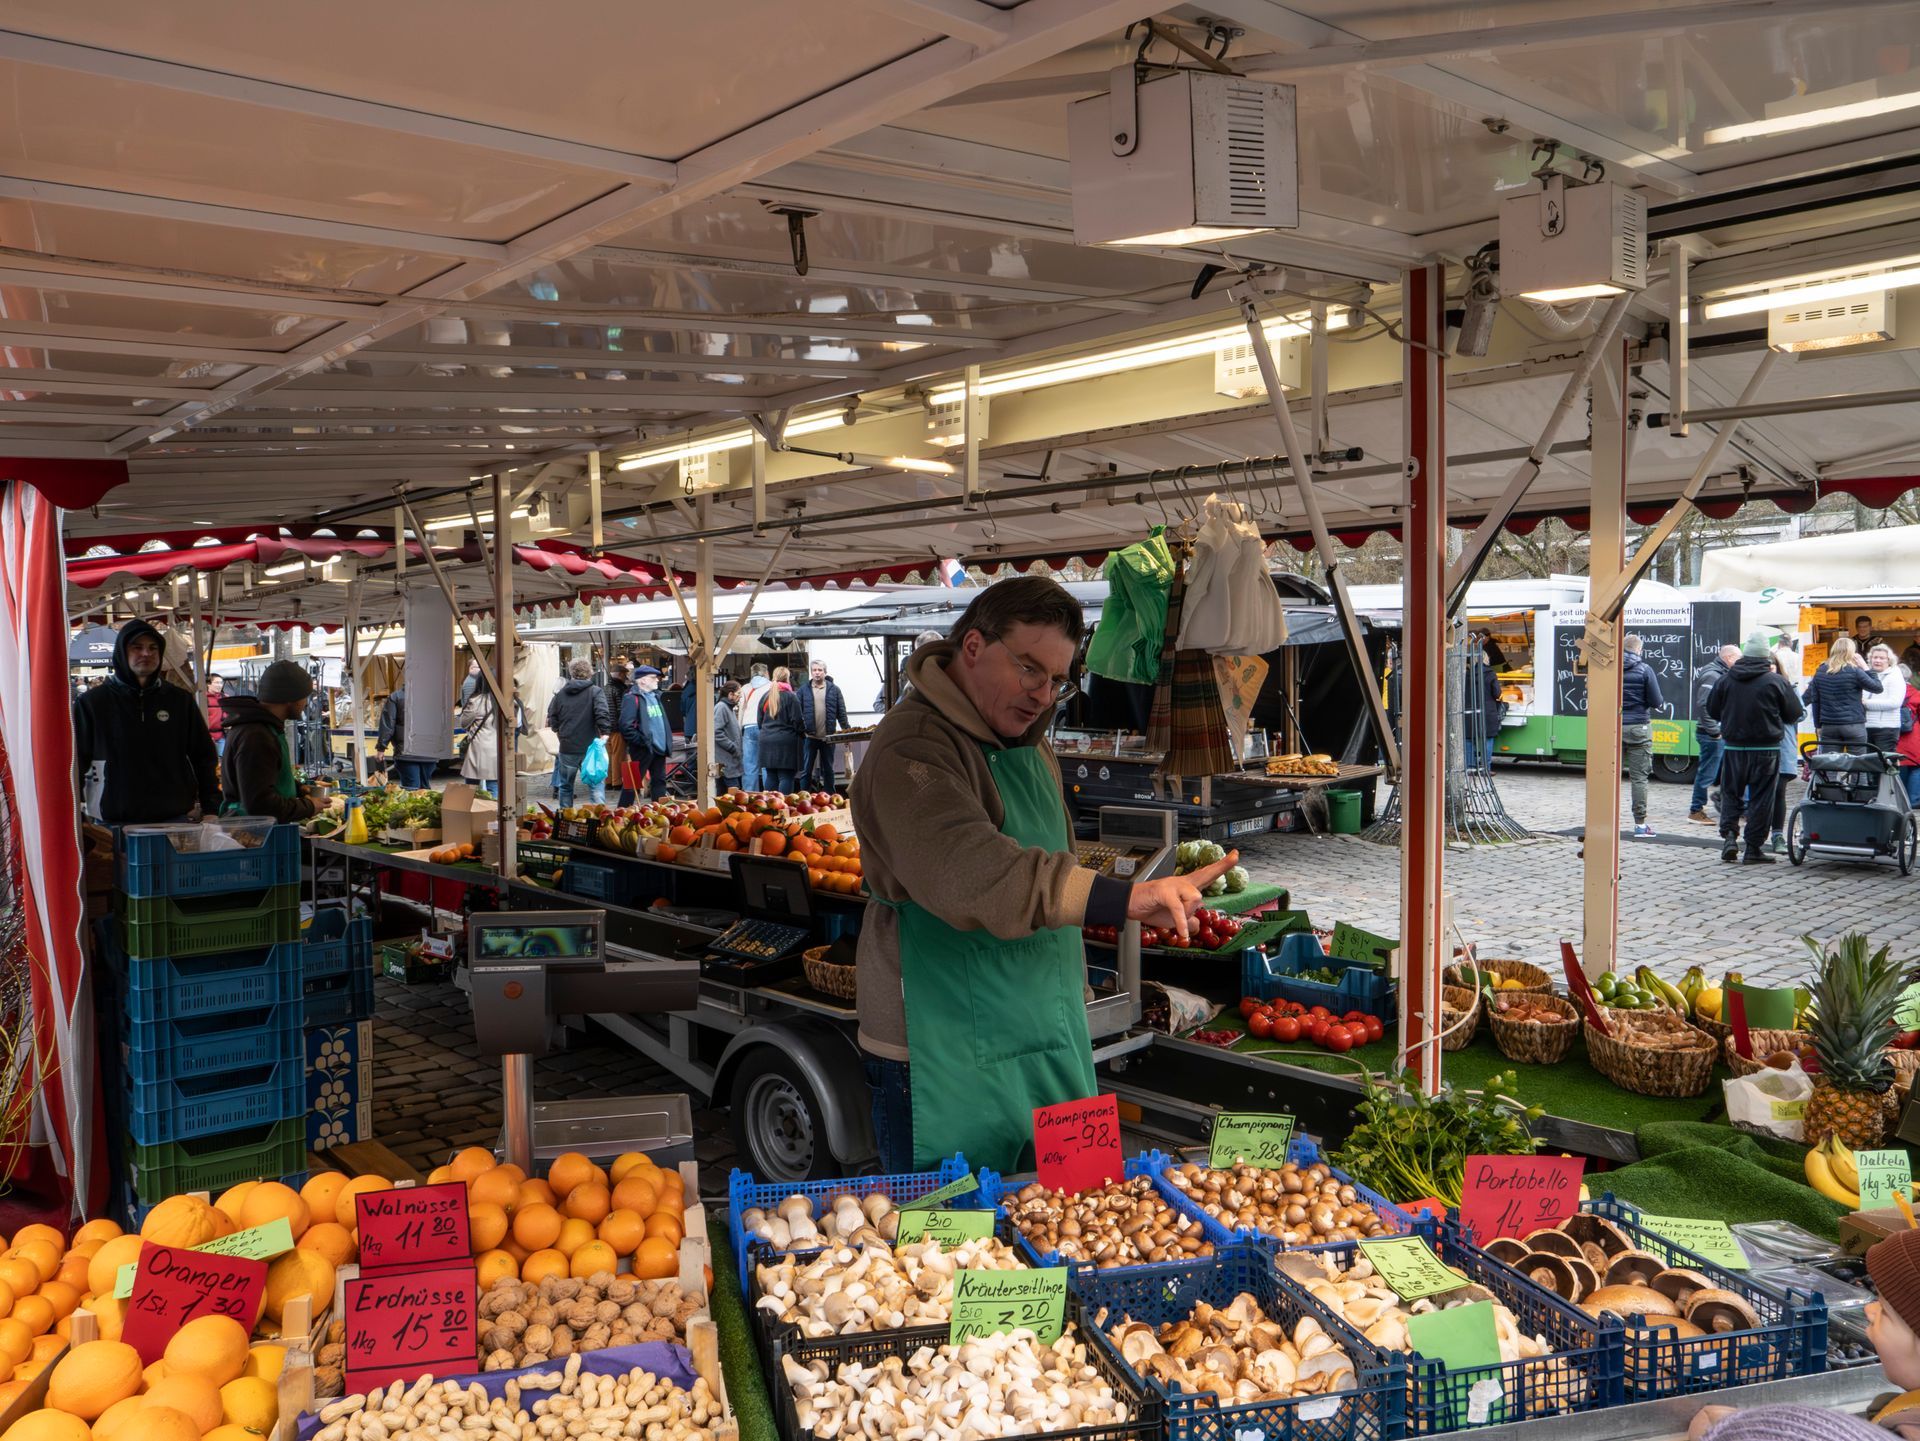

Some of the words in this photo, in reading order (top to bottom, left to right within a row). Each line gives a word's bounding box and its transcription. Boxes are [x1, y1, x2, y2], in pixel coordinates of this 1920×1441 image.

[1559, 607, 1573, 616] seit
[1576, 607, 1588, 616] übe
[1635, 606, 1690, 616] Wochenmarkt
[1038, 1105, 1115, 1128] Champignons
[1219, 1117, 1291, 1134] Champignons
[1860, 1152, 1905, 1167] Datteln
[1475, 1164, 1568, 1191] Portobello
[361, 1198, 460, 1217] Walnüsse
[1537, 1198, 1561, 1218] 90
[925, 1211, 953, 1228] Bio
[395, 1220, 424, 1250] 11
[432, 1216, 457, 1232] 80
[147, 1248, 252, 1297] Orangen
[957, 1271, 1065, 1300] Kräuterseitlinge
[211, 1296, 247, 1316] 30
[355, 1283, 467, 1312] Erdnüsse
[1021, 1301, 1050, 1321] 20
[351, 1330, 377, 1355] 1kg
[392, 1312, 433, 1352] 15
[442, 1309, 468, 1328] 80
